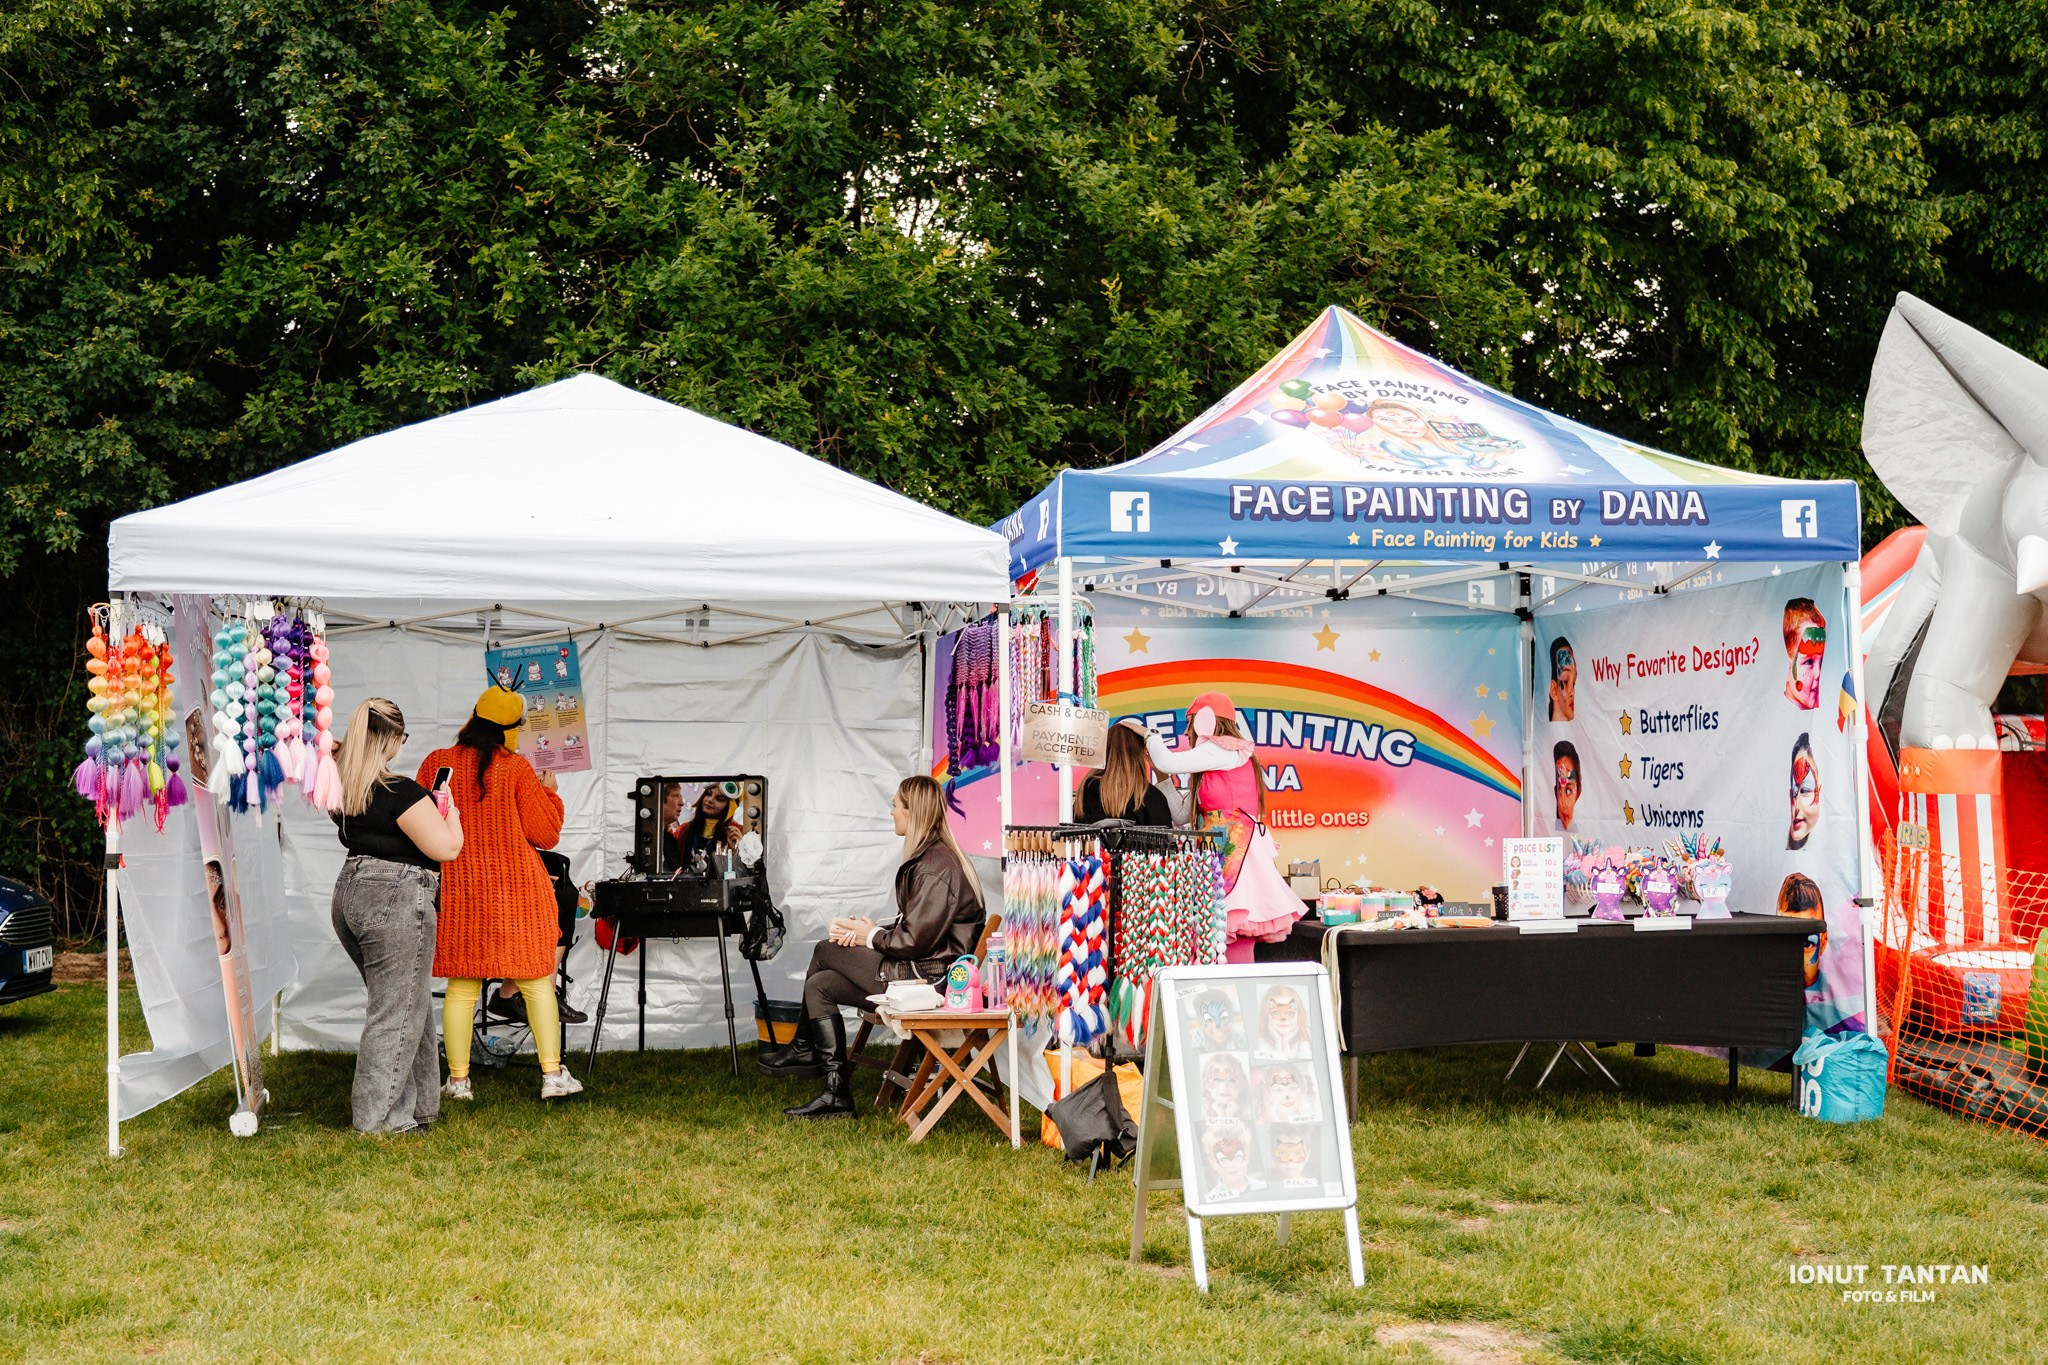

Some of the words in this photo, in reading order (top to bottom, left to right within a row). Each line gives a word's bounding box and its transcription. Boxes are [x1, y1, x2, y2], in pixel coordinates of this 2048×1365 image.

[1312, 380, 1363, 394] FACE
[1368, 379, 1470, 405] PAINTING
[1342, 389, 1368, 399] BY
[1376, 389, 1437, 404] DANA
[1231, 485, 1332, 518] FACE
[1345, 486, 1530, 520] PAINTING
[1551, 499, 1582, 520] BY
[1601, 490, 1707, 521] DANA
[1371, 529, 1416, 547] Face
[1423, 529, 1497, 552] Painting
[1503, 530, 1534, 549] for
[1540, 530, 1578, 549] Kids
[1591, 656, 1622, 687] Why
[1626, 650, 1687, 679] Favorite
[1692, 637, 1760, 676] Designs?
[1029, 704, 1061, 717] CASH
[1064, 707, 1072, 718] &
[1074, 709, 1106, 722] CARD
[1640, 704, 1719, 734] Butterflies
[1032, 729, 1099, 747] PAYMENTS
[1034, 742, 1096, 757] ACCEPTED
[1235, 709, 1416, 766] AINTING
[1261, 765, 1302, 791] NA
[1640, 756, 1684, 788] Tigers
[1271, 809, 1316, 828] little
[1320, 811, 1370, 827] ones
[1640, 803, 1705, 829] Unicorns
[1513, 843, 1537, 854] PRICE
